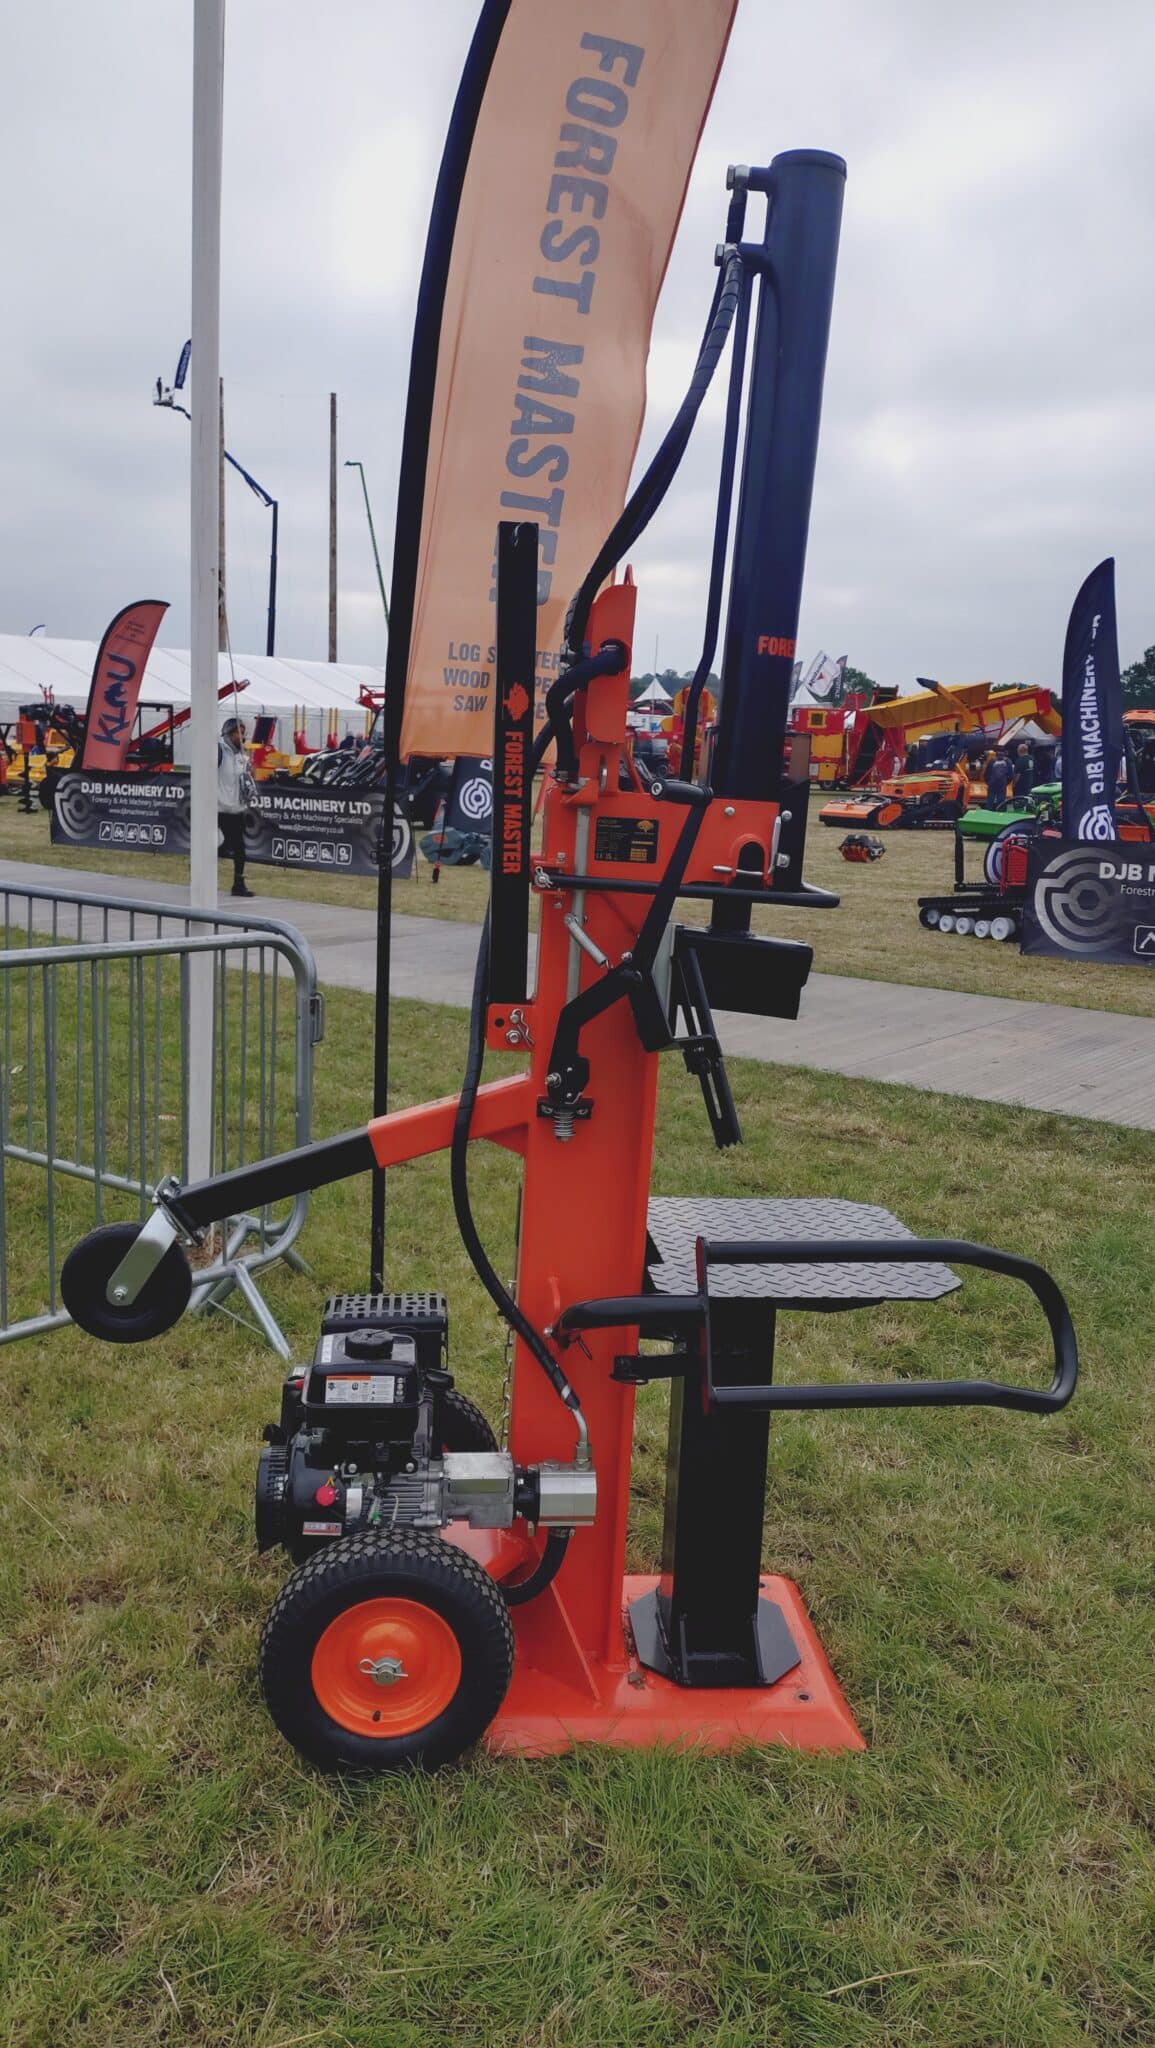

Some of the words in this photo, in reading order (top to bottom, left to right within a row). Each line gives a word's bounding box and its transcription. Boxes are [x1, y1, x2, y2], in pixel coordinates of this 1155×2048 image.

[533, 32, 645, 315] FOREST
[488, 335, 585, 606] MAST
[448, 640, 481, 663] LOG
[443, 667, 490, 689] WOOD
[453, 694, 488, 713] SAW
[504, 731, 524, 798] FOREST
[81, 782, 102, 794] DJB
[105, 783, 163, 798] MACHINERY
[165, 786, 185, 799] LTD
[250, 796, 271, 808] DJB
[274, 797, 346, 813] MACHINERY
[349, 801, 372, 815] LTD
[503, 804, 523, 874] MASTER
[1099, 862, 1143, 881] DJB
